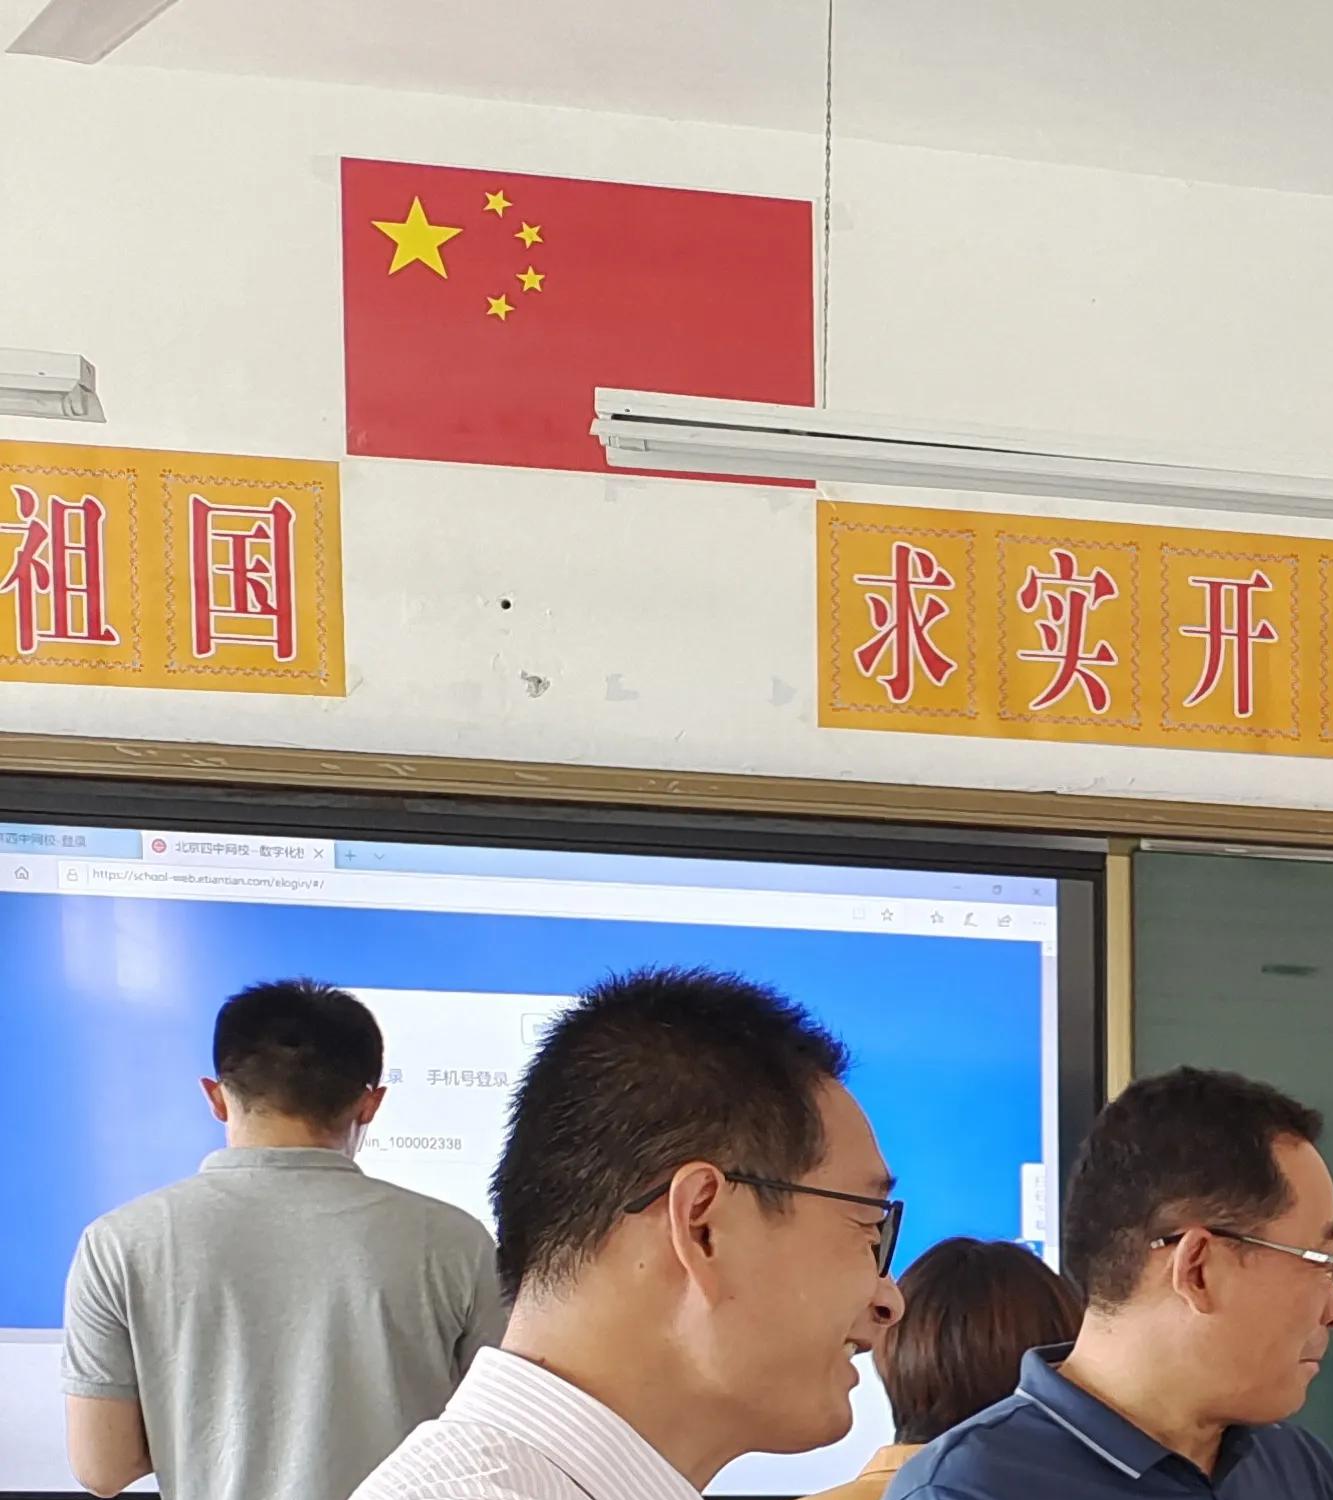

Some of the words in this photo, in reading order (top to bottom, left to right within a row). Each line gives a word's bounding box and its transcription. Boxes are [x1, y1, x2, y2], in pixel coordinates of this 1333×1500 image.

[0, 484, 297, 662] 祖国
[426, 1069, 511, 1087] 手机号登录
